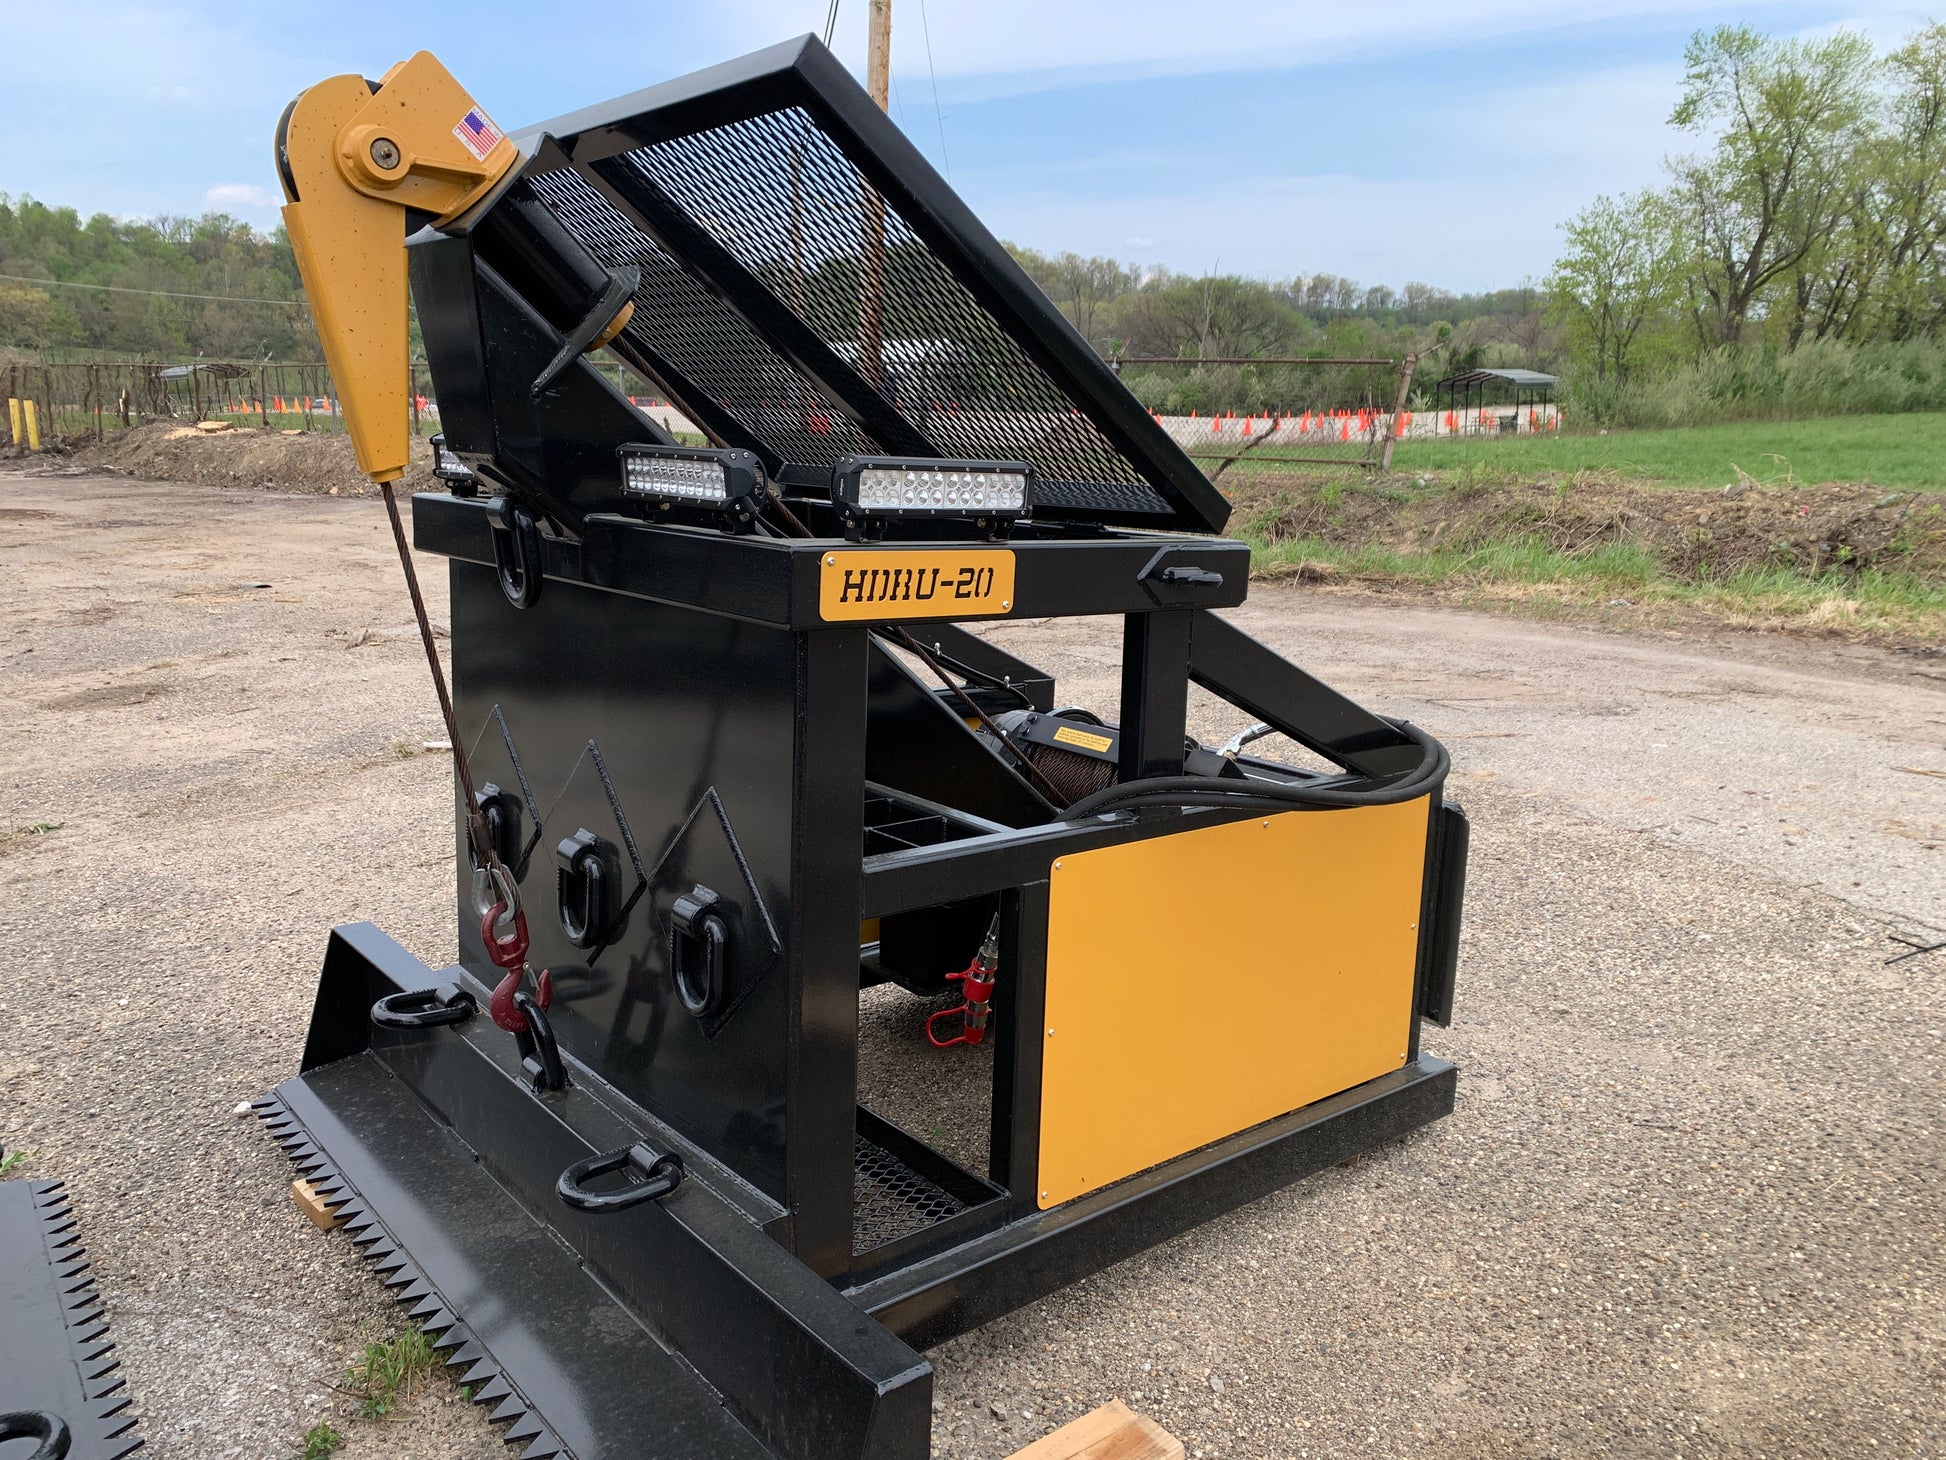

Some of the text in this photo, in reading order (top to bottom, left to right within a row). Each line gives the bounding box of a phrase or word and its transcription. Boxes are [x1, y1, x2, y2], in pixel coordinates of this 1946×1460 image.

[473, 106, 502, 139] MADE IN
[840, 567, 993, 602] HDRU-20
